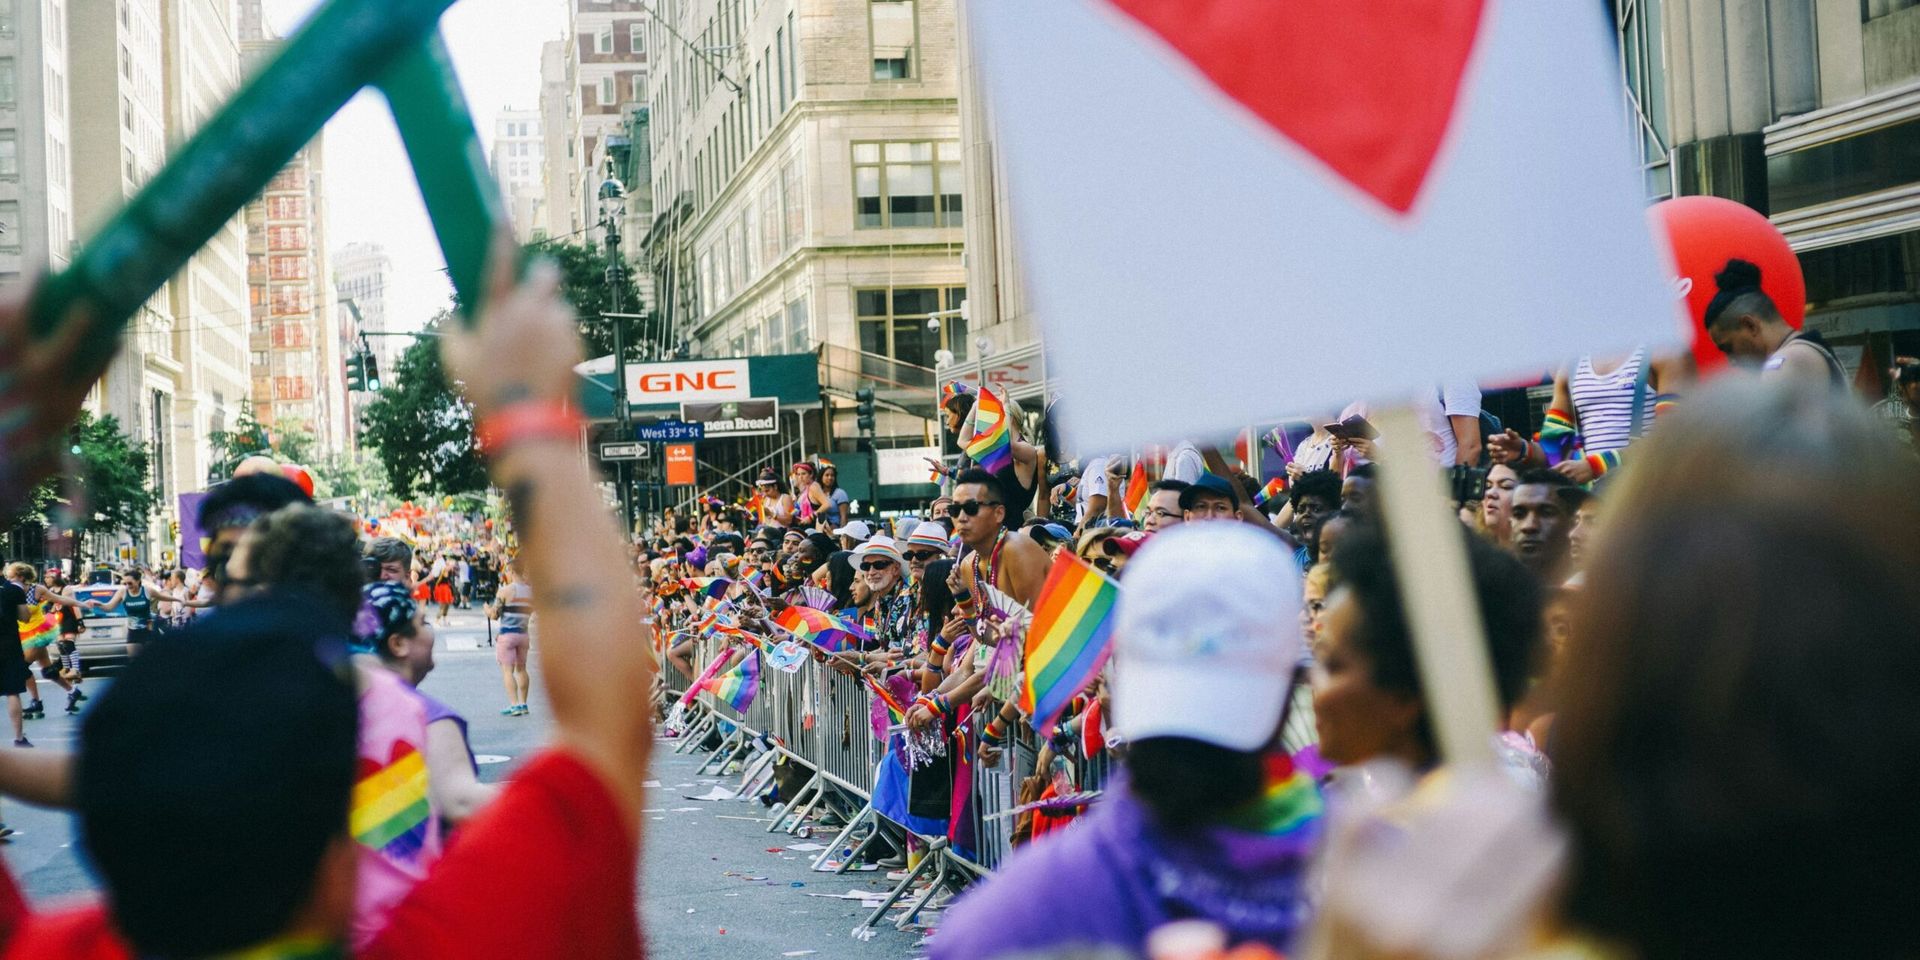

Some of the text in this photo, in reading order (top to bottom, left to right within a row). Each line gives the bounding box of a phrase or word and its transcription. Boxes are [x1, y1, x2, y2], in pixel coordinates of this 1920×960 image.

[640, 370, 736, 392] GNC
[704, 416, 773, 431] nera Bread
[641, 427, 699, 439] West 33rd St
